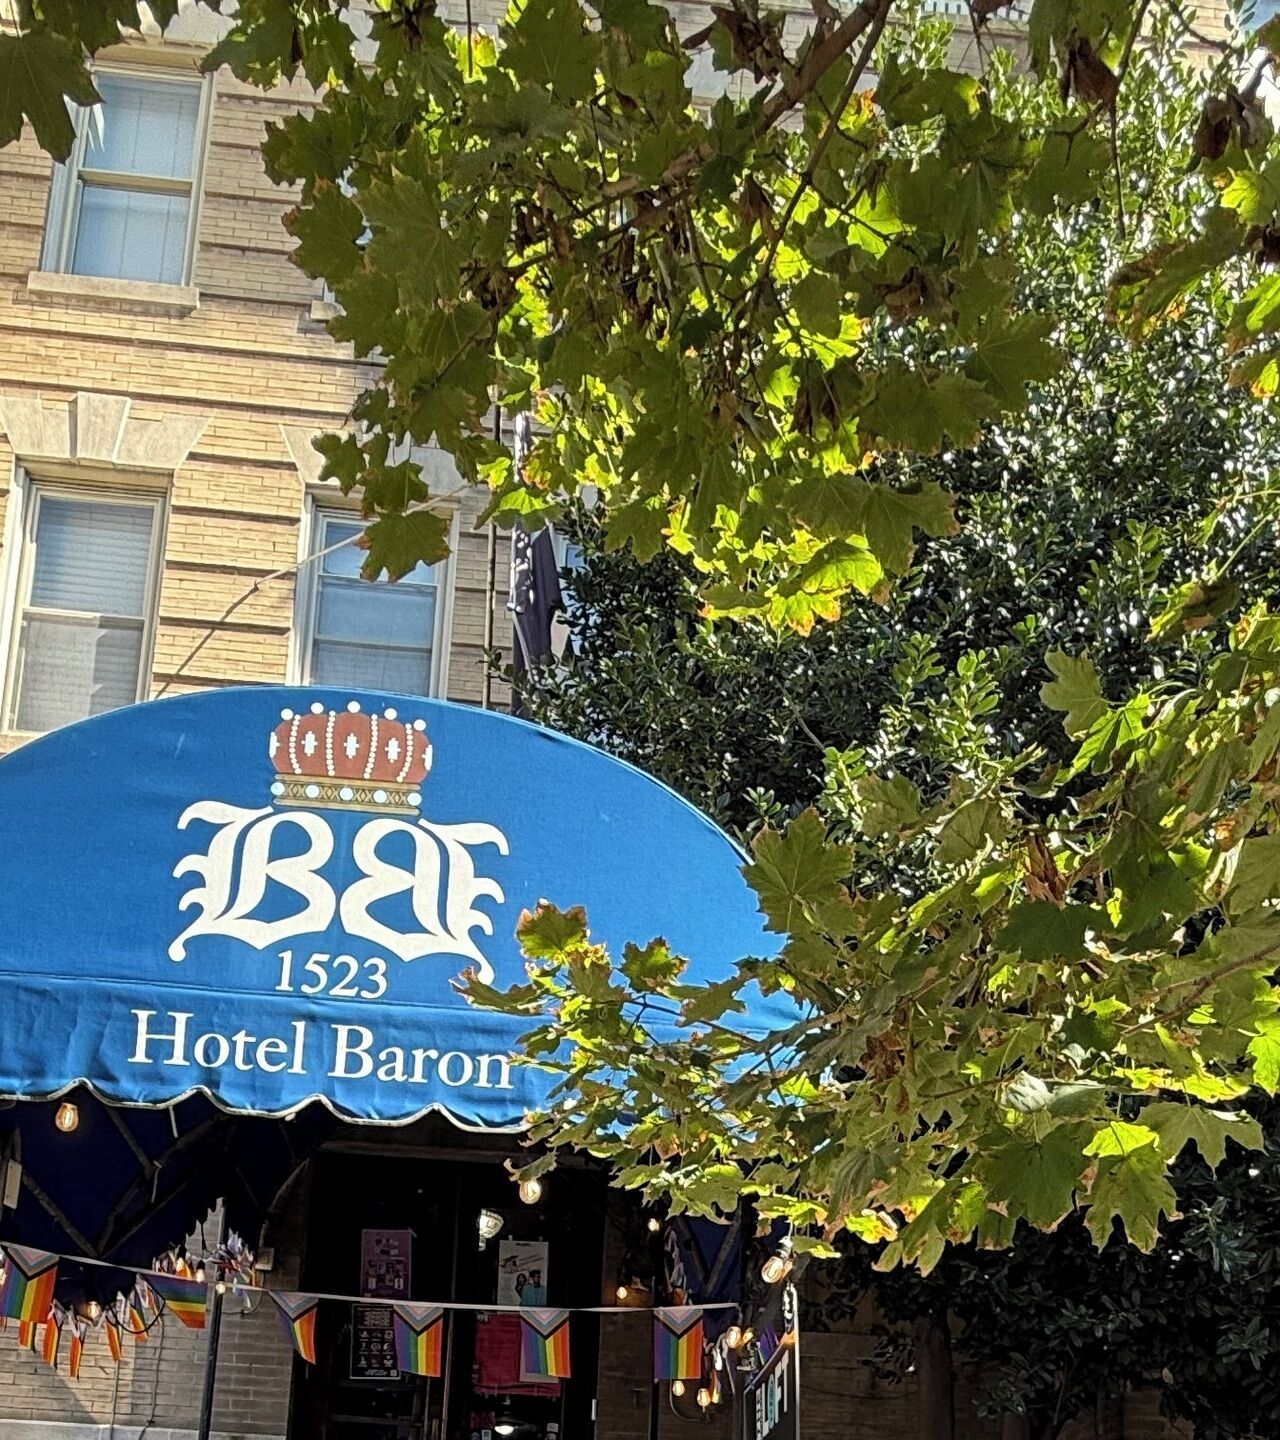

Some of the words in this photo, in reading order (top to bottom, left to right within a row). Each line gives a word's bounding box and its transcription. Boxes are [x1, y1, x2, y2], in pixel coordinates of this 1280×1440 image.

[275, 950, 388, 999] 1523
[128, 1009, 308, 1074] Hotel
[328, 1024, 515, 1090] Baron
